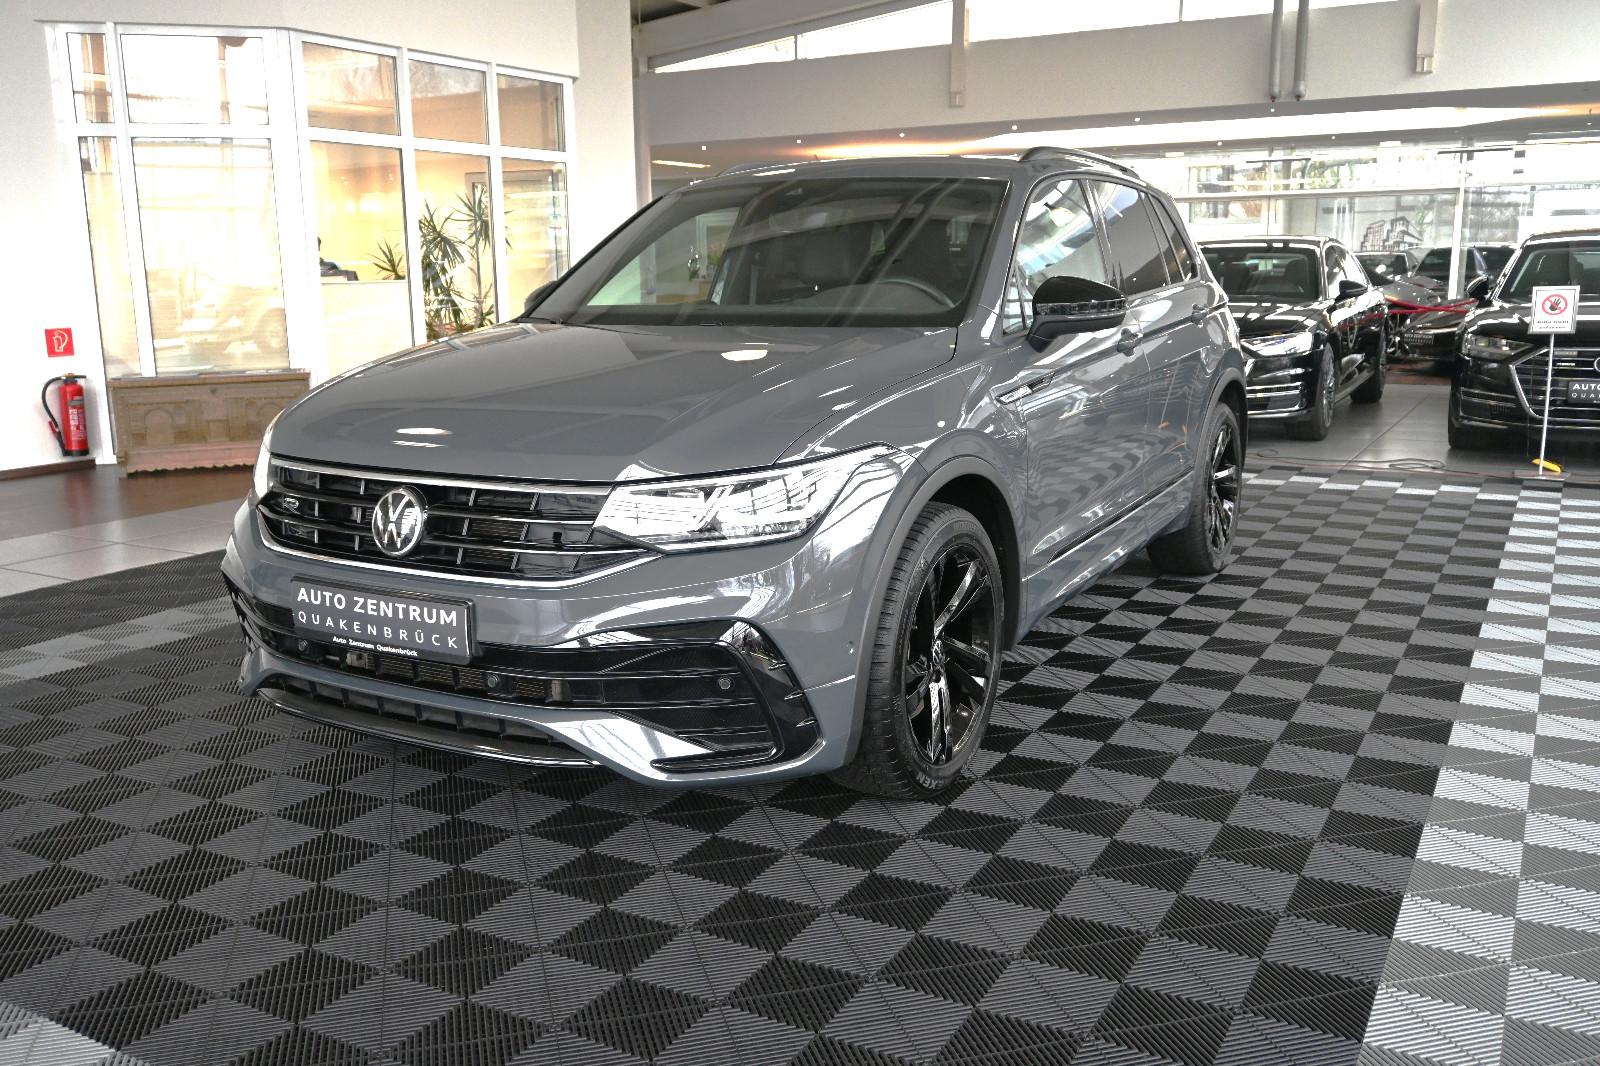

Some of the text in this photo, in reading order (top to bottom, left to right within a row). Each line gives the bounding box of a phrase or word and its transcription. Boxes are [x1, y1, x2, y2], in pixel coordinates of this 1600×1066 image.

[297, 587, 457, 627] AUTO ZENTRUM
[298, 611, 458, 649] QUAKENBRÜCK
[332, 635, 418, 657] Auto Zentrum Quakenbrück
